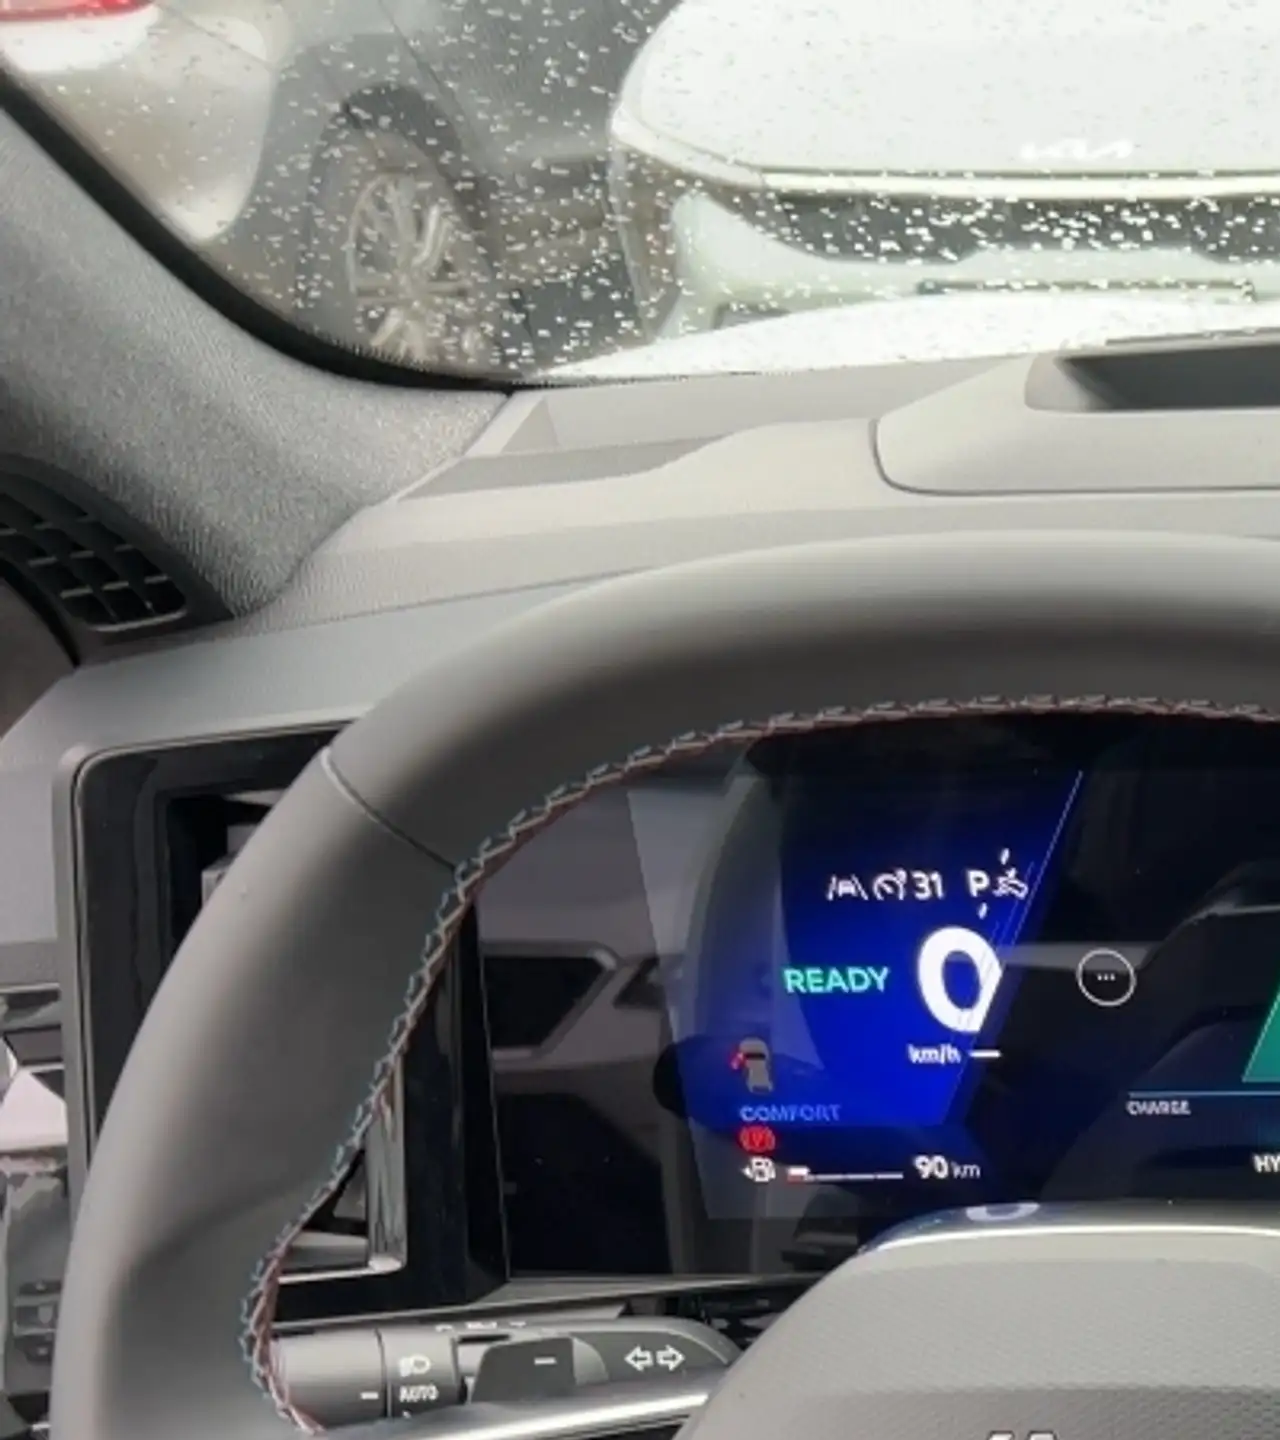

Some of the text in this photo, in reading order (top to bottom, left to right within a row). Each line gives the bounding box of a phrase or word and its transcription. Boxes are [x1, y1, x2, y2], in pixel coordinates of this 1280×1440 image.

[914, 872, 944, 900] 31
[783, 966, 889, 994] READY
[917, 925, 1003, 1033] 0
[908, 1044, 961, 1064] km/h
[739, 1103, 841, 1123] COMFORT
[1126, 1100, 1191, 1115] CHARGE
[914, 1156, 981, 1180] 90 km
[400, 1384, 439, 1402] AUTO
